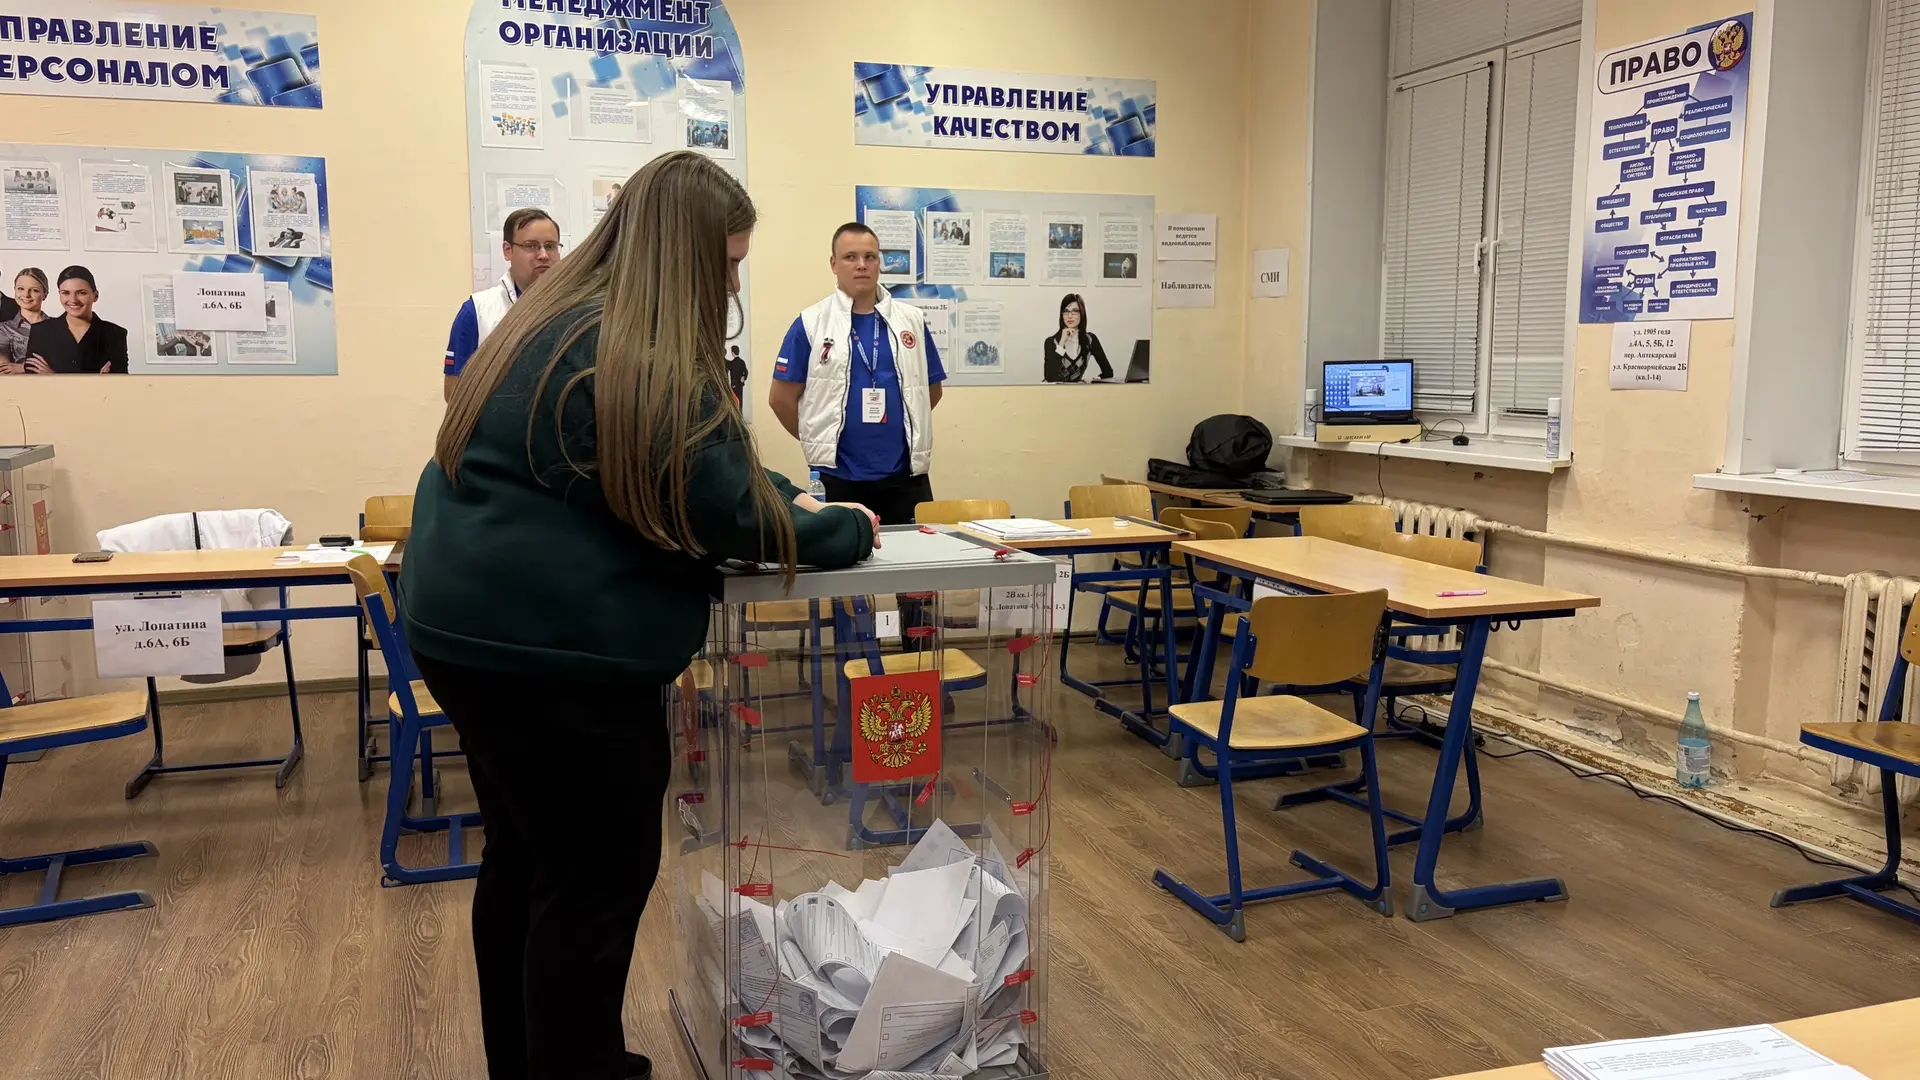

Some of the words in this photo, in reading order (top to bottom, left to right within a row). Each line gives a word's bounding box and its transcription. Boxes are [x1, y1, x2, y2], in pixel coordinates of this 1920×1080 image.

[499, 20, 713, 58] ОРГАНИЗАЦИИ
[1609, 41, 1702, 85] ПРАВО
[925, 83, 1088, 111] УПРАВЛЕНИЕ
[1685, 102, 1728, 115] РЕАЛИСТИЧЕСКАЯ
[933, 115, 1080, 142] КАЧЕСТВОМ
[1608, 120, 1644, 131] ТЕОЛОГИЧЕСКАЯ
[1653, 125, 1676, 135] ПРАВО
[1680, 127, 1727, 140] СОЦИОЛОГИЧЕСКАЯ
[1675, 163, 1697, 171] СИСТЕМА
[1658, 189, 1688, 198] РОССИЙСКОЕ
[1688, 187, 1705, 195] ПРАВО
[1695, 206, 1718, 214] ЧАСТНОЕ
[1616, 248, 1647, 256] ГОСУДАРСТВО
[1260, 271, 1280, 284] СМИ
[1635, 277, 1654, 285] СУДЫ
[1161, 281, 1212, 290] Наблюдатель
[196, 287, 246, 297] Лопатина
[229, 301, 242, 310] 6Б
[1653, 340, 1664, 348] 5Б,
[1637, 352, 1677, 360] Аптекарский
[1622, 363, 1676, 372] Красноармейская
[1677, 363, 1687, 371] 2Б
[1058, 570, 1070, 579] 2Б
[885, 614, 890, 626] 1
[115, 624, 135, 635] ул.
[139, 621, 207, 632] Лопатина
[134, 638, 169, 650] д.6А,
[172, 636, 190, 647] 6Б
